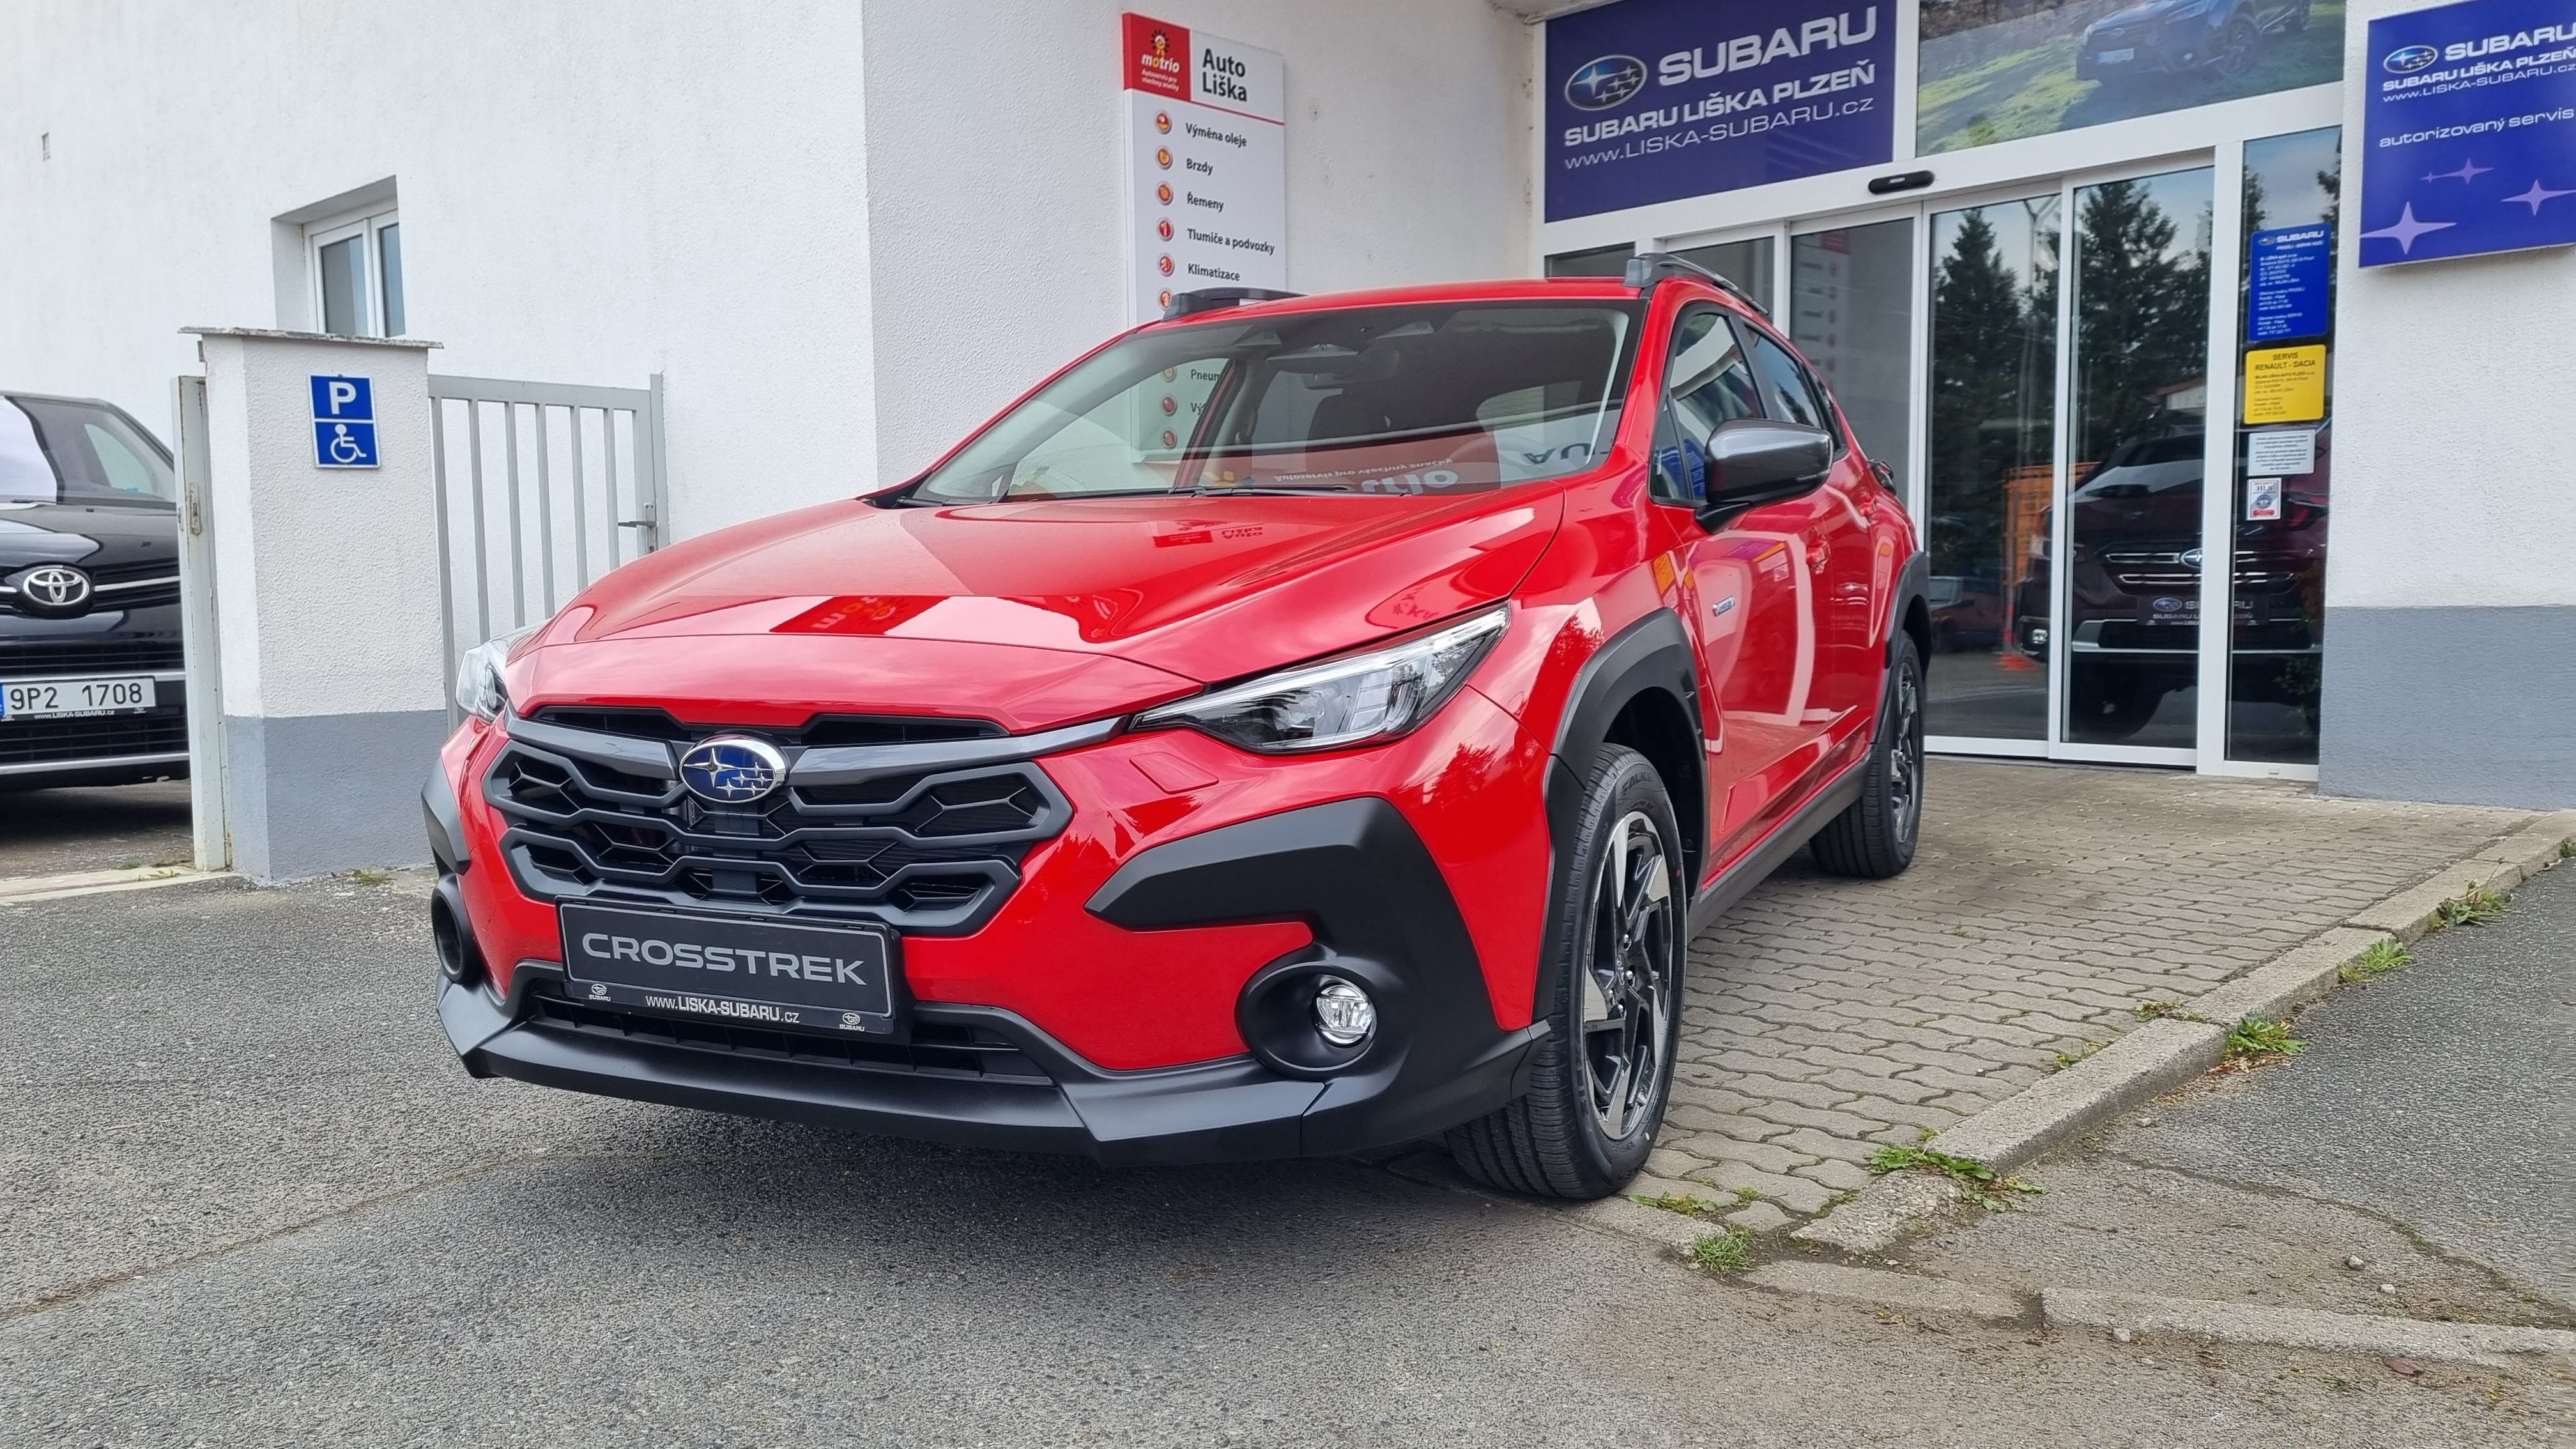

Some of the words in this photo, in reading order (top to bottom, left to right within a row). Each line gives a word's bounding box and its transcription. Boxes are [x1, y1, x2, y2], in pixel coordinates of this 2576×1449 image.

[1658, 5, 1877, 87] SUBARU
[2444, 22, 2576, 61] SUBARU
[1141, 54, 1180, 73] motrio
[1203, 49, 1246, 77] Auto
[2382, 69, 2457, 92] SUBARU
[2460, 59, 2513, 78] LIŠKA
[2516, 46, 2576, 68] PLZEŇ
[1202, 72, 1248, 102] Liška
[2383, 64, 2576, 103] www.LISKA-SUBARU.cz
[1565, 107, 1679, 147] SUBARU
[1683, 89, 1768, 123] LIŠKA
[1773, 59, 1876, 104] PLZEŇ
[1186, 123, 1223, 142] Výměna
[1225, 132, 1247, 148] oleje
[1565, 98, 1874, 170] www.LISKA-SUBARU.cz
[2379, 118, 2505, 148] autorizovaný
[2508, 108, 2575, 127] servis
[1186, 158, 1214, 176] Brzdy
[1186, 191, 1224, 213] Řemeny
[1187, 228, 1224, 245] Tlumiče
[1225, 236, 1231, 246] a
[1232, 237, 1275, 256] podvozky
[2276, 230, 2324, 243] SUBARU
[1188, 263, 1240, 282] Klimatizace
[2255, 362, 2288, 371] RENAULT
[2294, 360, 2316, 368] DACIA
[2273, 351, 2299, 360] SERVIS
[329, 381, 356, 415] P
[10, 686, 59, 711] 9P2
[82, 682, 143, 707] 1708
[581, 932, 868, 986] CROSSTREK
[839, 1023, 865, 1032] SUBARU
